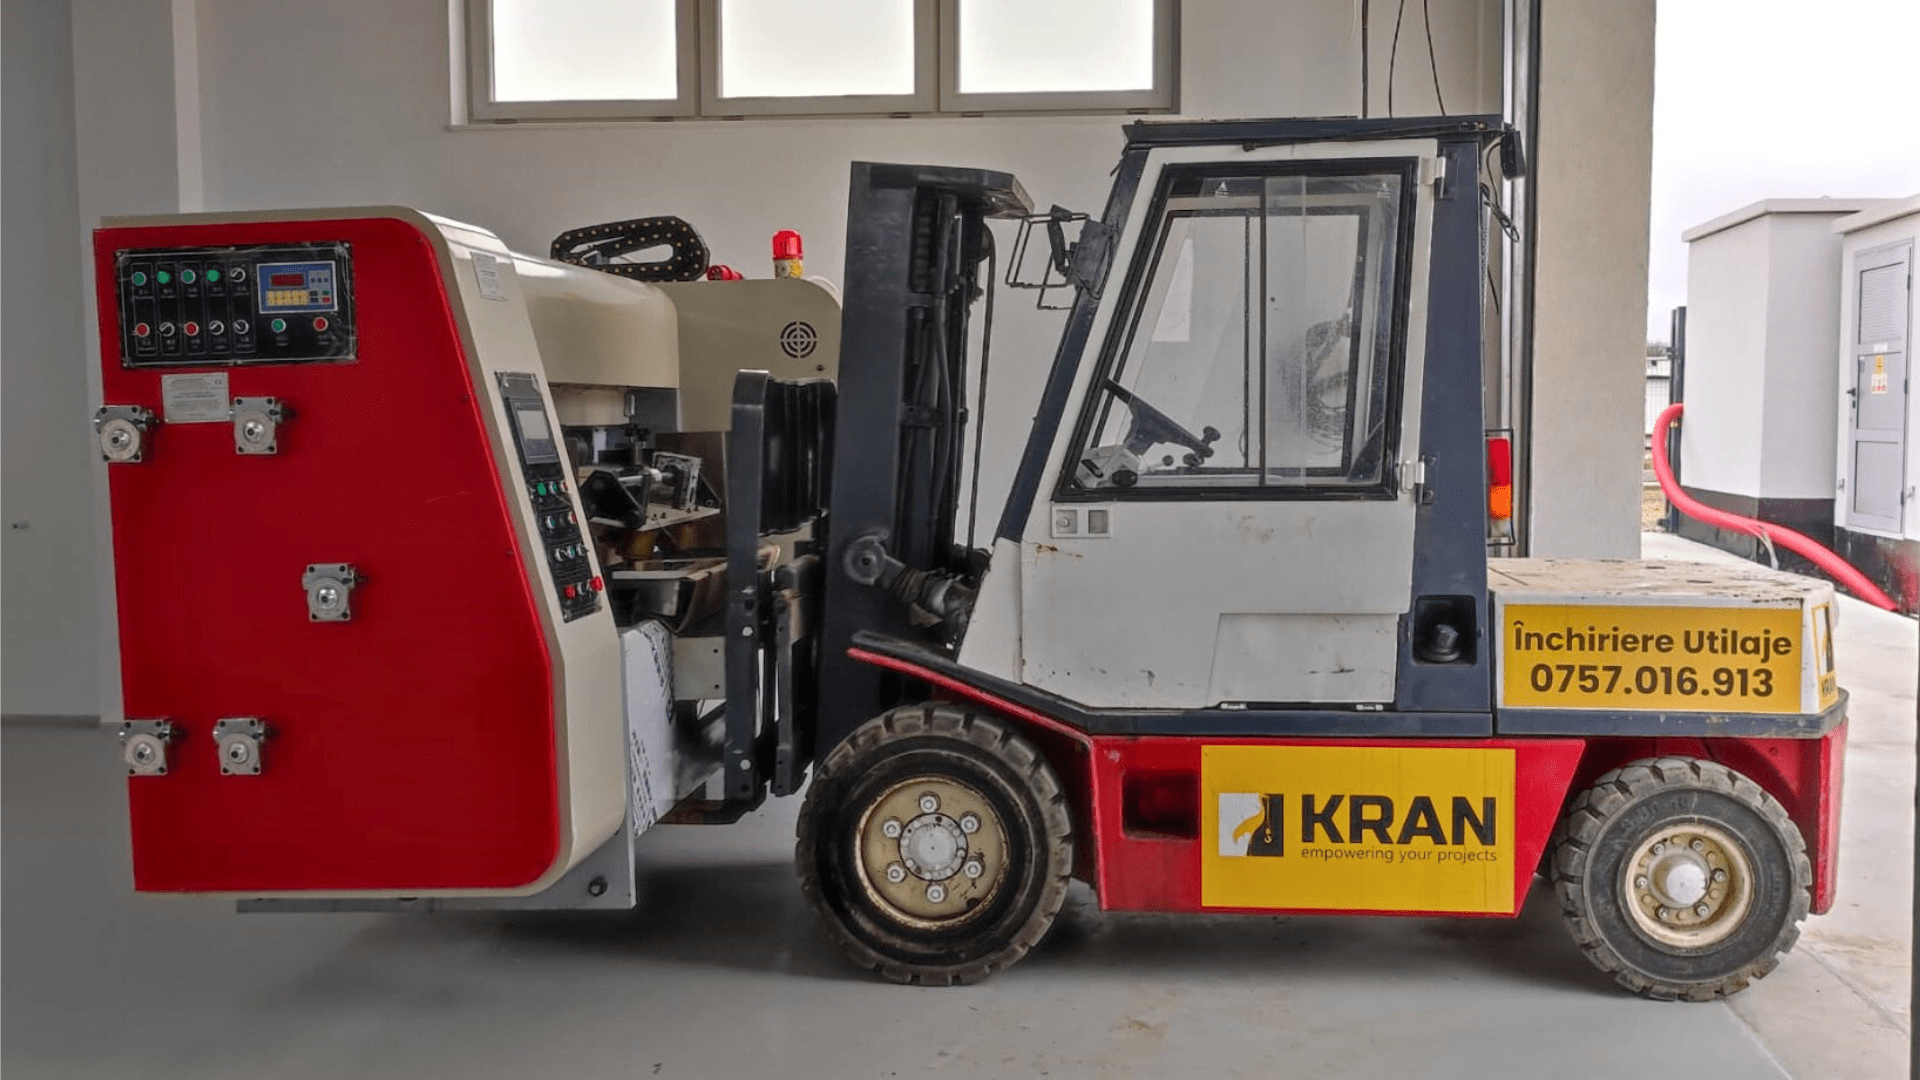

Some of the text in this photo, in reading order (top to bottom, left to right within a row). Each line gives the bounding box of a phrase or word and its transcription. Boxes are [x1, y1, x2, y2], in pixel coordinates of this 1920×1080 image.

[1513, 620, 1792, 663] Închiriere Utilaje
[1530, 663, 1773, 697] 0757.016.913
[1301, 794, 1497, 846] KRAN
[1301, 847, 1498, 864] empowering your projects
